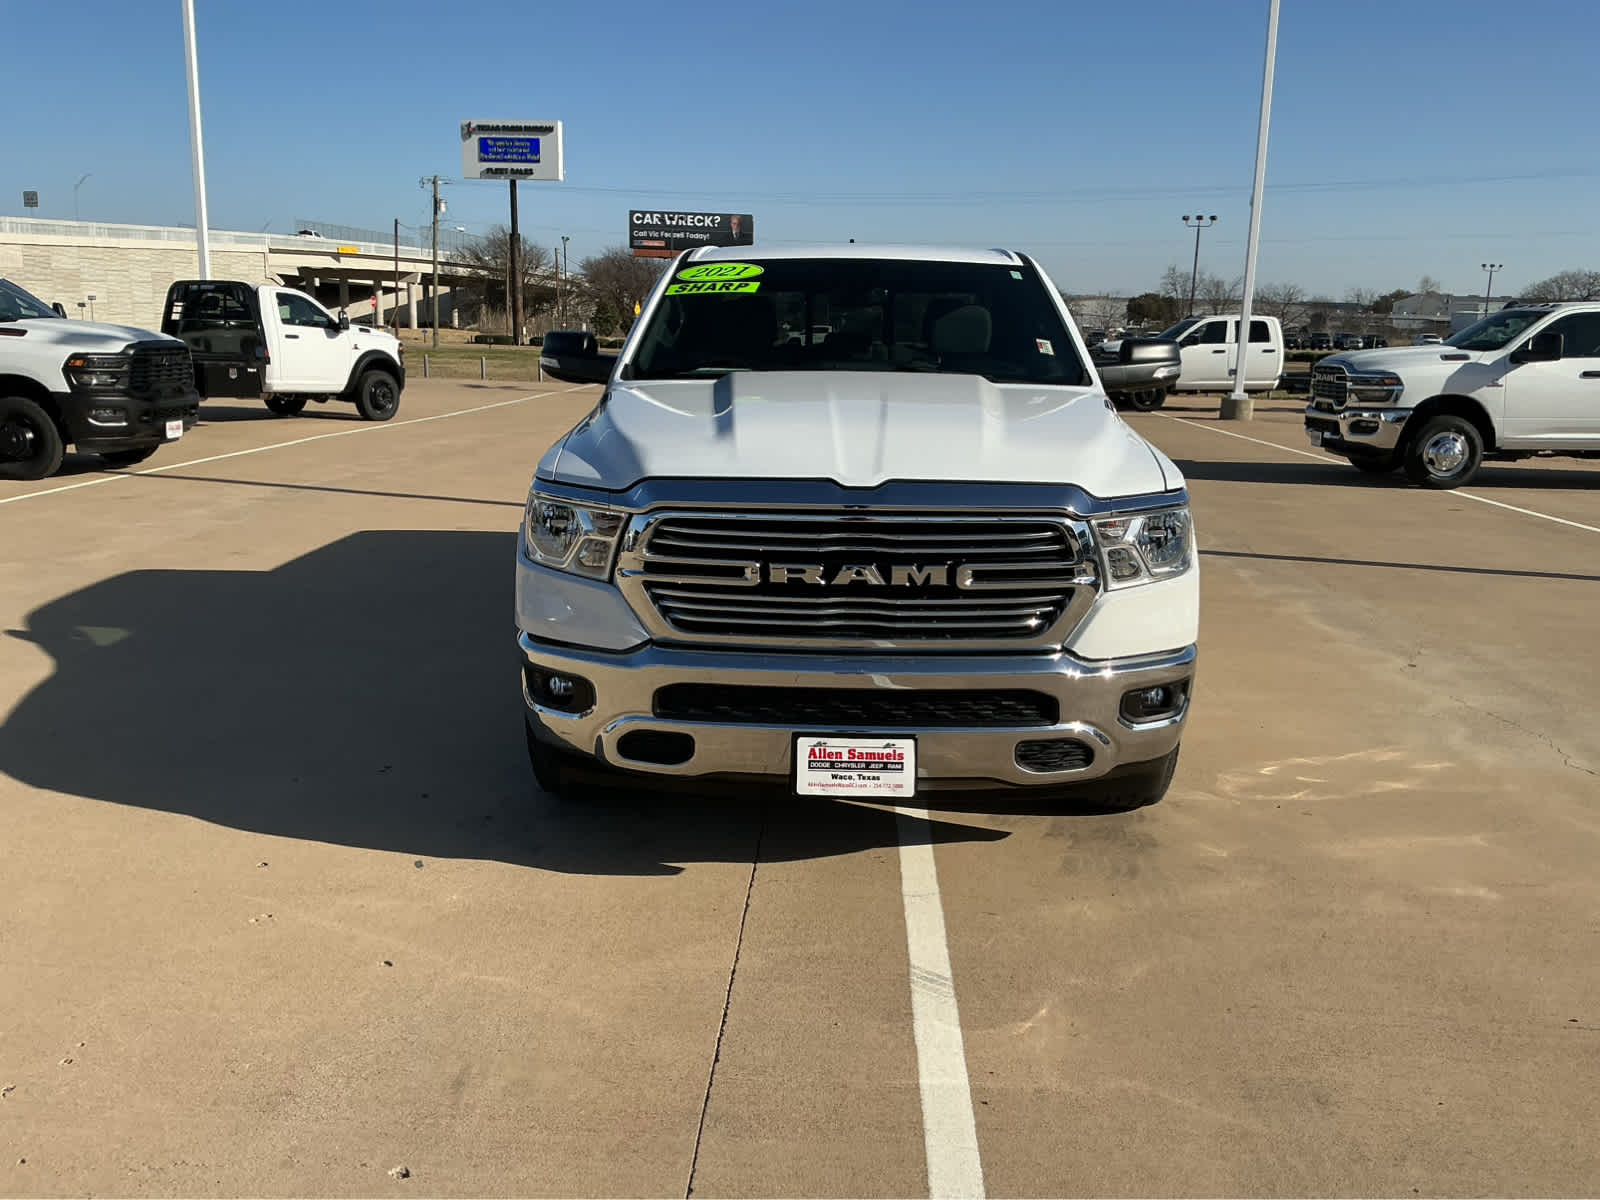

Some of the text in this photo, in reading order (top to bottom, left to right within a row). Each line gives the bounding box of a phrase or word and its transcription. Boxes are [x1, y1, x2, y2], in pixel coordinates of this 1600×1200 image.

[632, 213, 721, 227] CAR WRECK?
[633, 230, 647, 238] Call
[689, 266, 751, 278] 2021
[674, 282, 750, 293] SHARP
[769, 562, 948, 586] RAM
[807, 747, 904, 761] Allen Samuels
[831, 773, 881, 781] Waco, Texas
